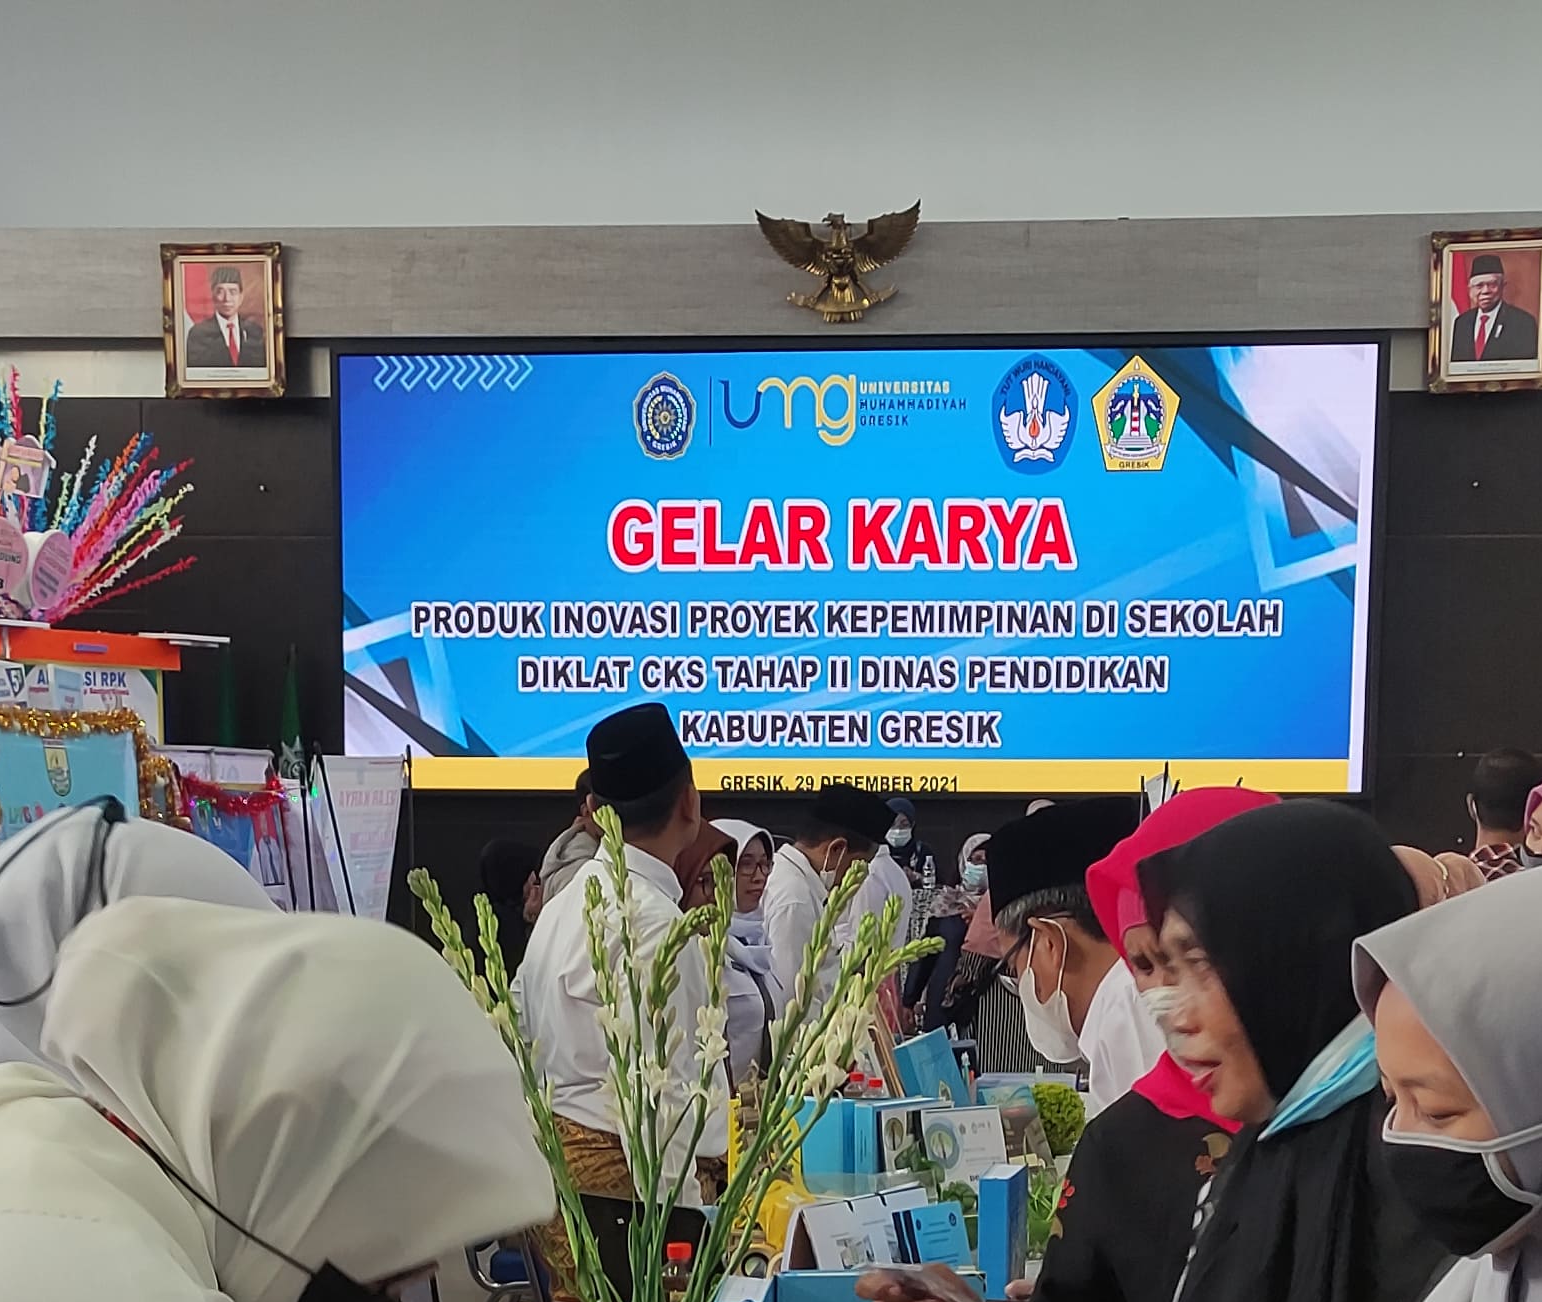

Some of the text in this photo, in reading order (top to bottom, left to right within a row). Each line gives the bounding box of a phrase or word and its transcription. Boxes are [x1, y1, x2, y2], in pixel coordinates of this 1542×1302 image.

[1012, 360, 1033, 379] WURI
[859, 380, 951, 394] UNIVERSITAS
[859, 397, 968, 411] MUHAMMADIYAH
[859, 414, 909, 427] GRESIK
[1118, 460, 1151, 469] GRESIK
[609, 498, 1078, 571] GELAR KARYA
[412, 600, 1282, 636] PRODUK INOVASI PROYEK KEPEMIMPINAN DI SEKOLAH
[100, 671, 127, 688] RPK
[519, 655, 1169, 692] DIKLAT CKS TAHAP II DINAS PENDIDIKAN
[680, 710, 1001, 746] KABUPATEN GRESIK
[796, 775, 815, 791] 29
[919, 775, 959, 792] 2021
